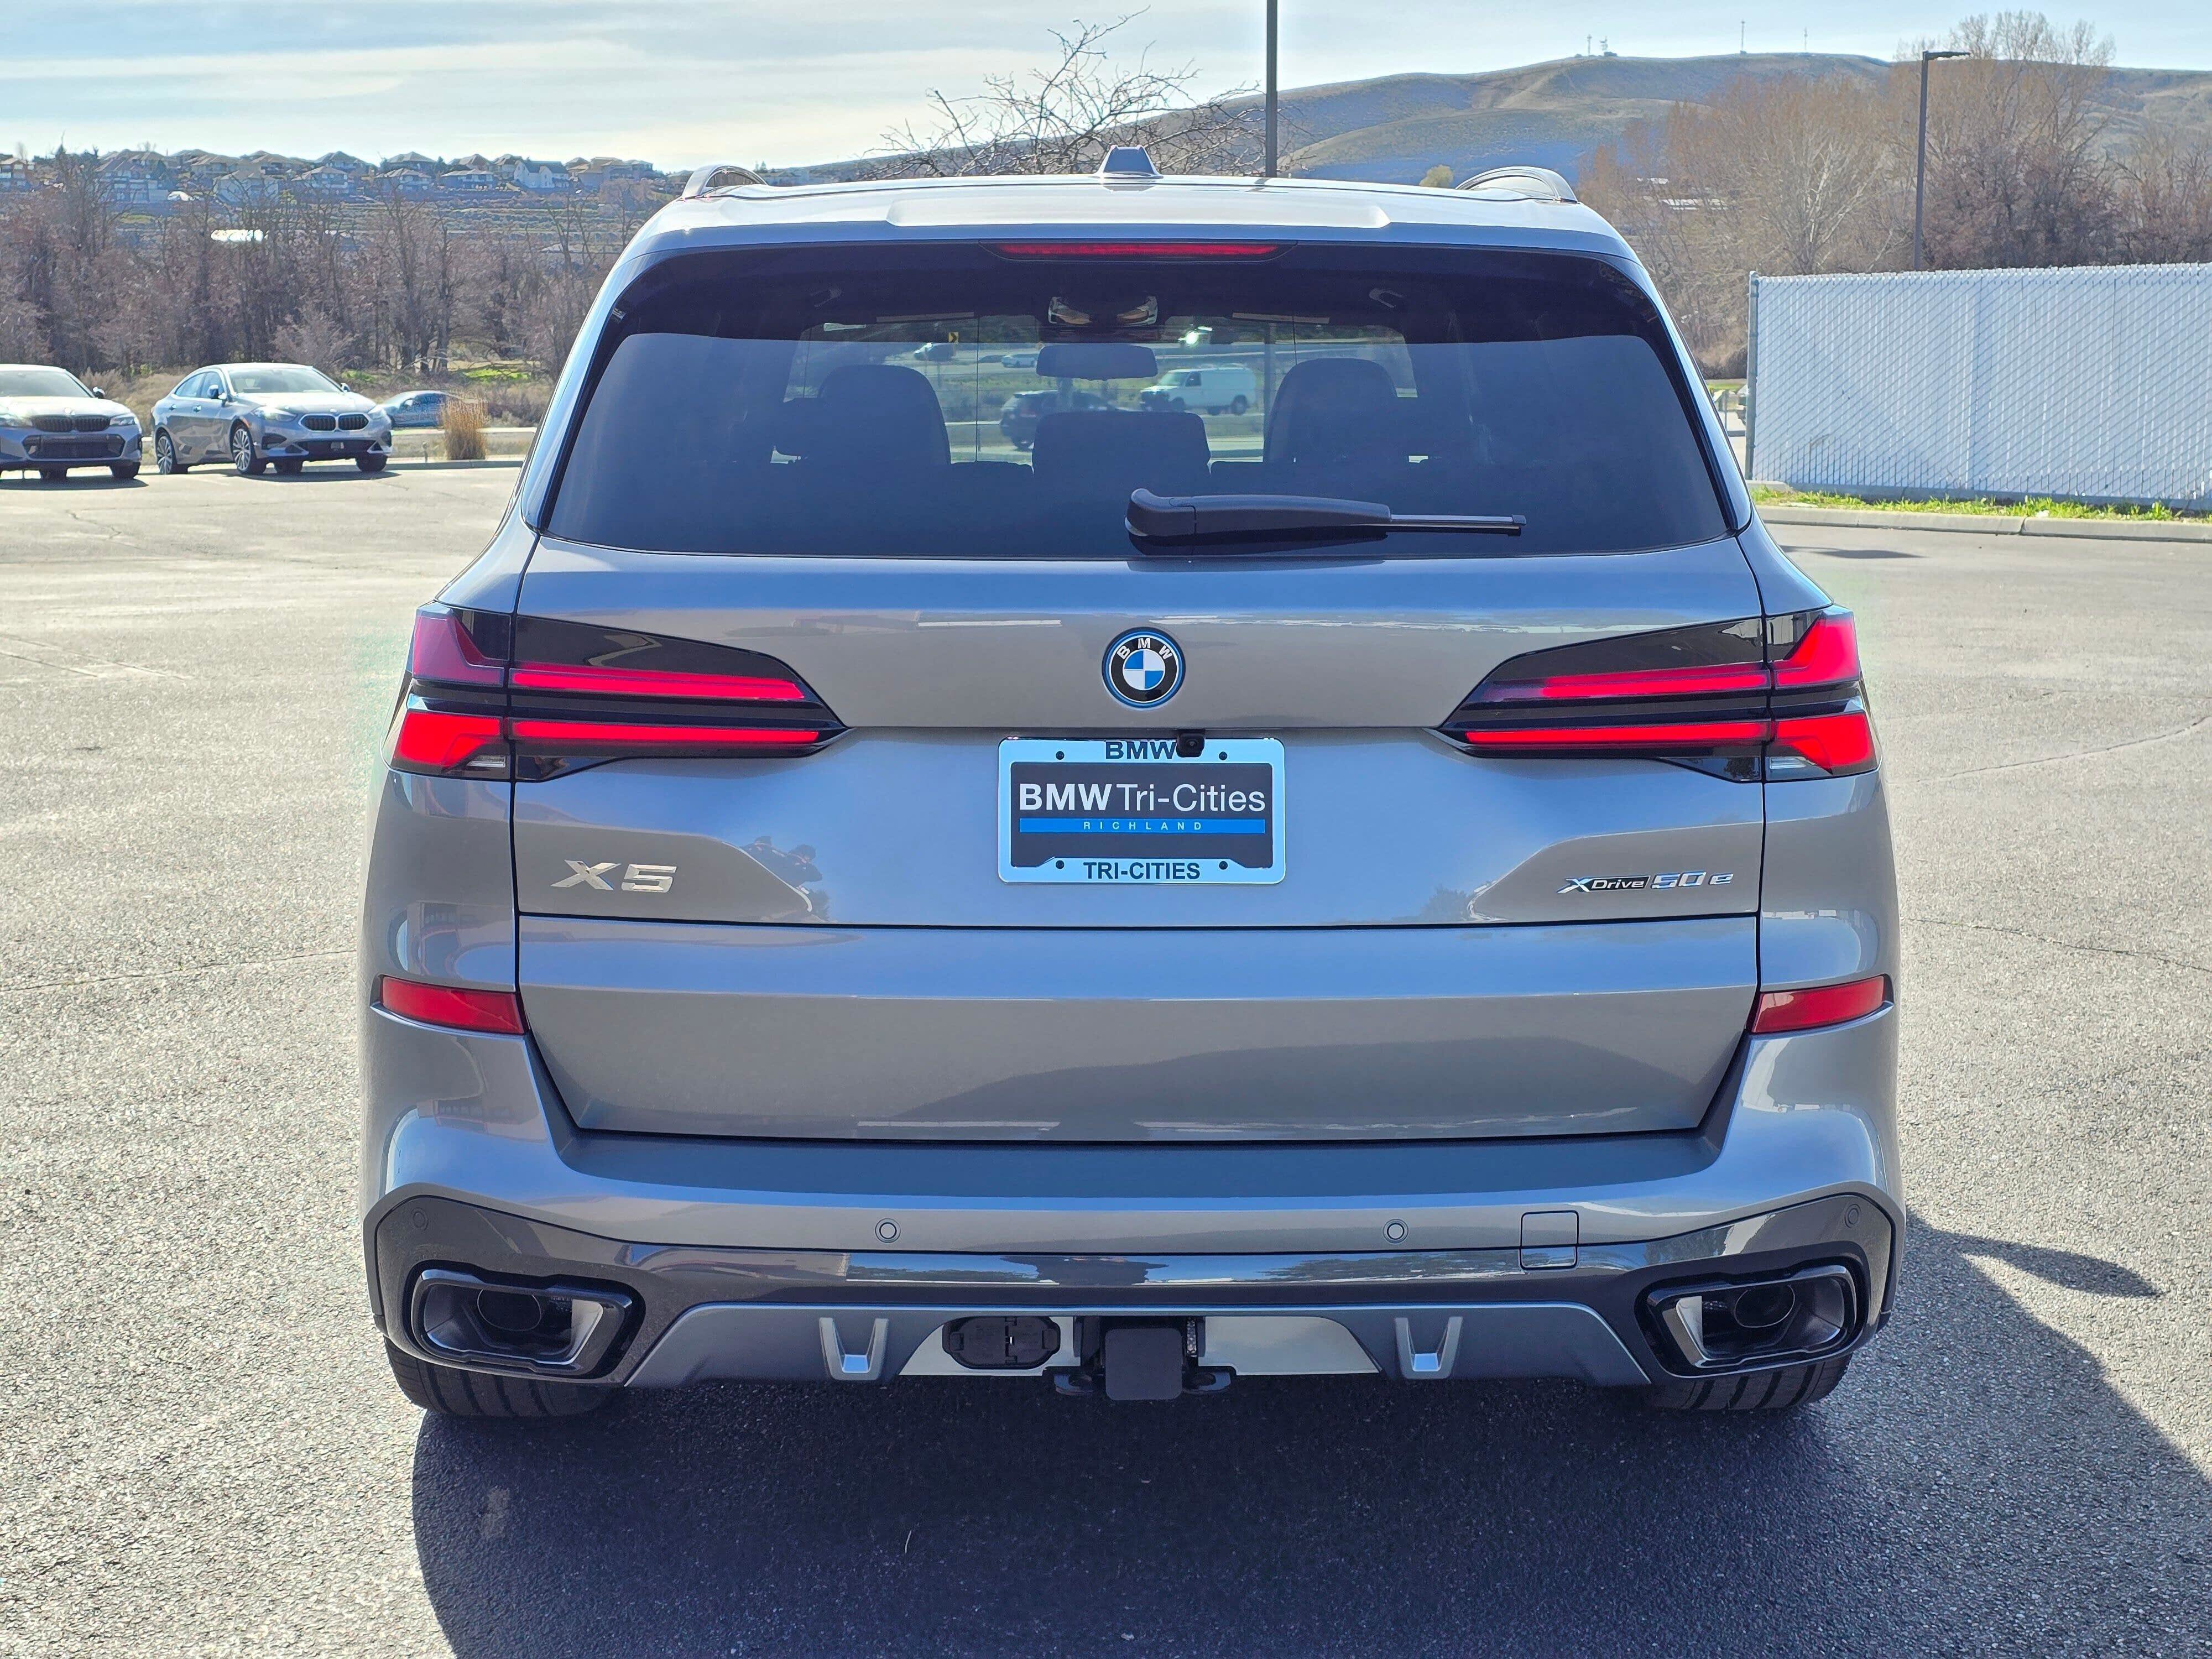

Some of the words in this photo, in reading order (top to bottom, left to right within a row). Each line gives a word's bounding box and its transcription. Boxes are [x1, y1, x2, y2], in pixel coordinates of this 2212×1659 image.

[1116, 638, 1173, 660] BMW
[1105, 742, 1177, 759] BMW
[1019, 783, 1112, 811] BMW
[1116, 783, 1265, 812] Tri-Cities
[1083, 821, 1202, 831] RICHLAND
[550, 859, 677, 893] X5
[1083, 862, 1201, 880] TRI-CITIES
